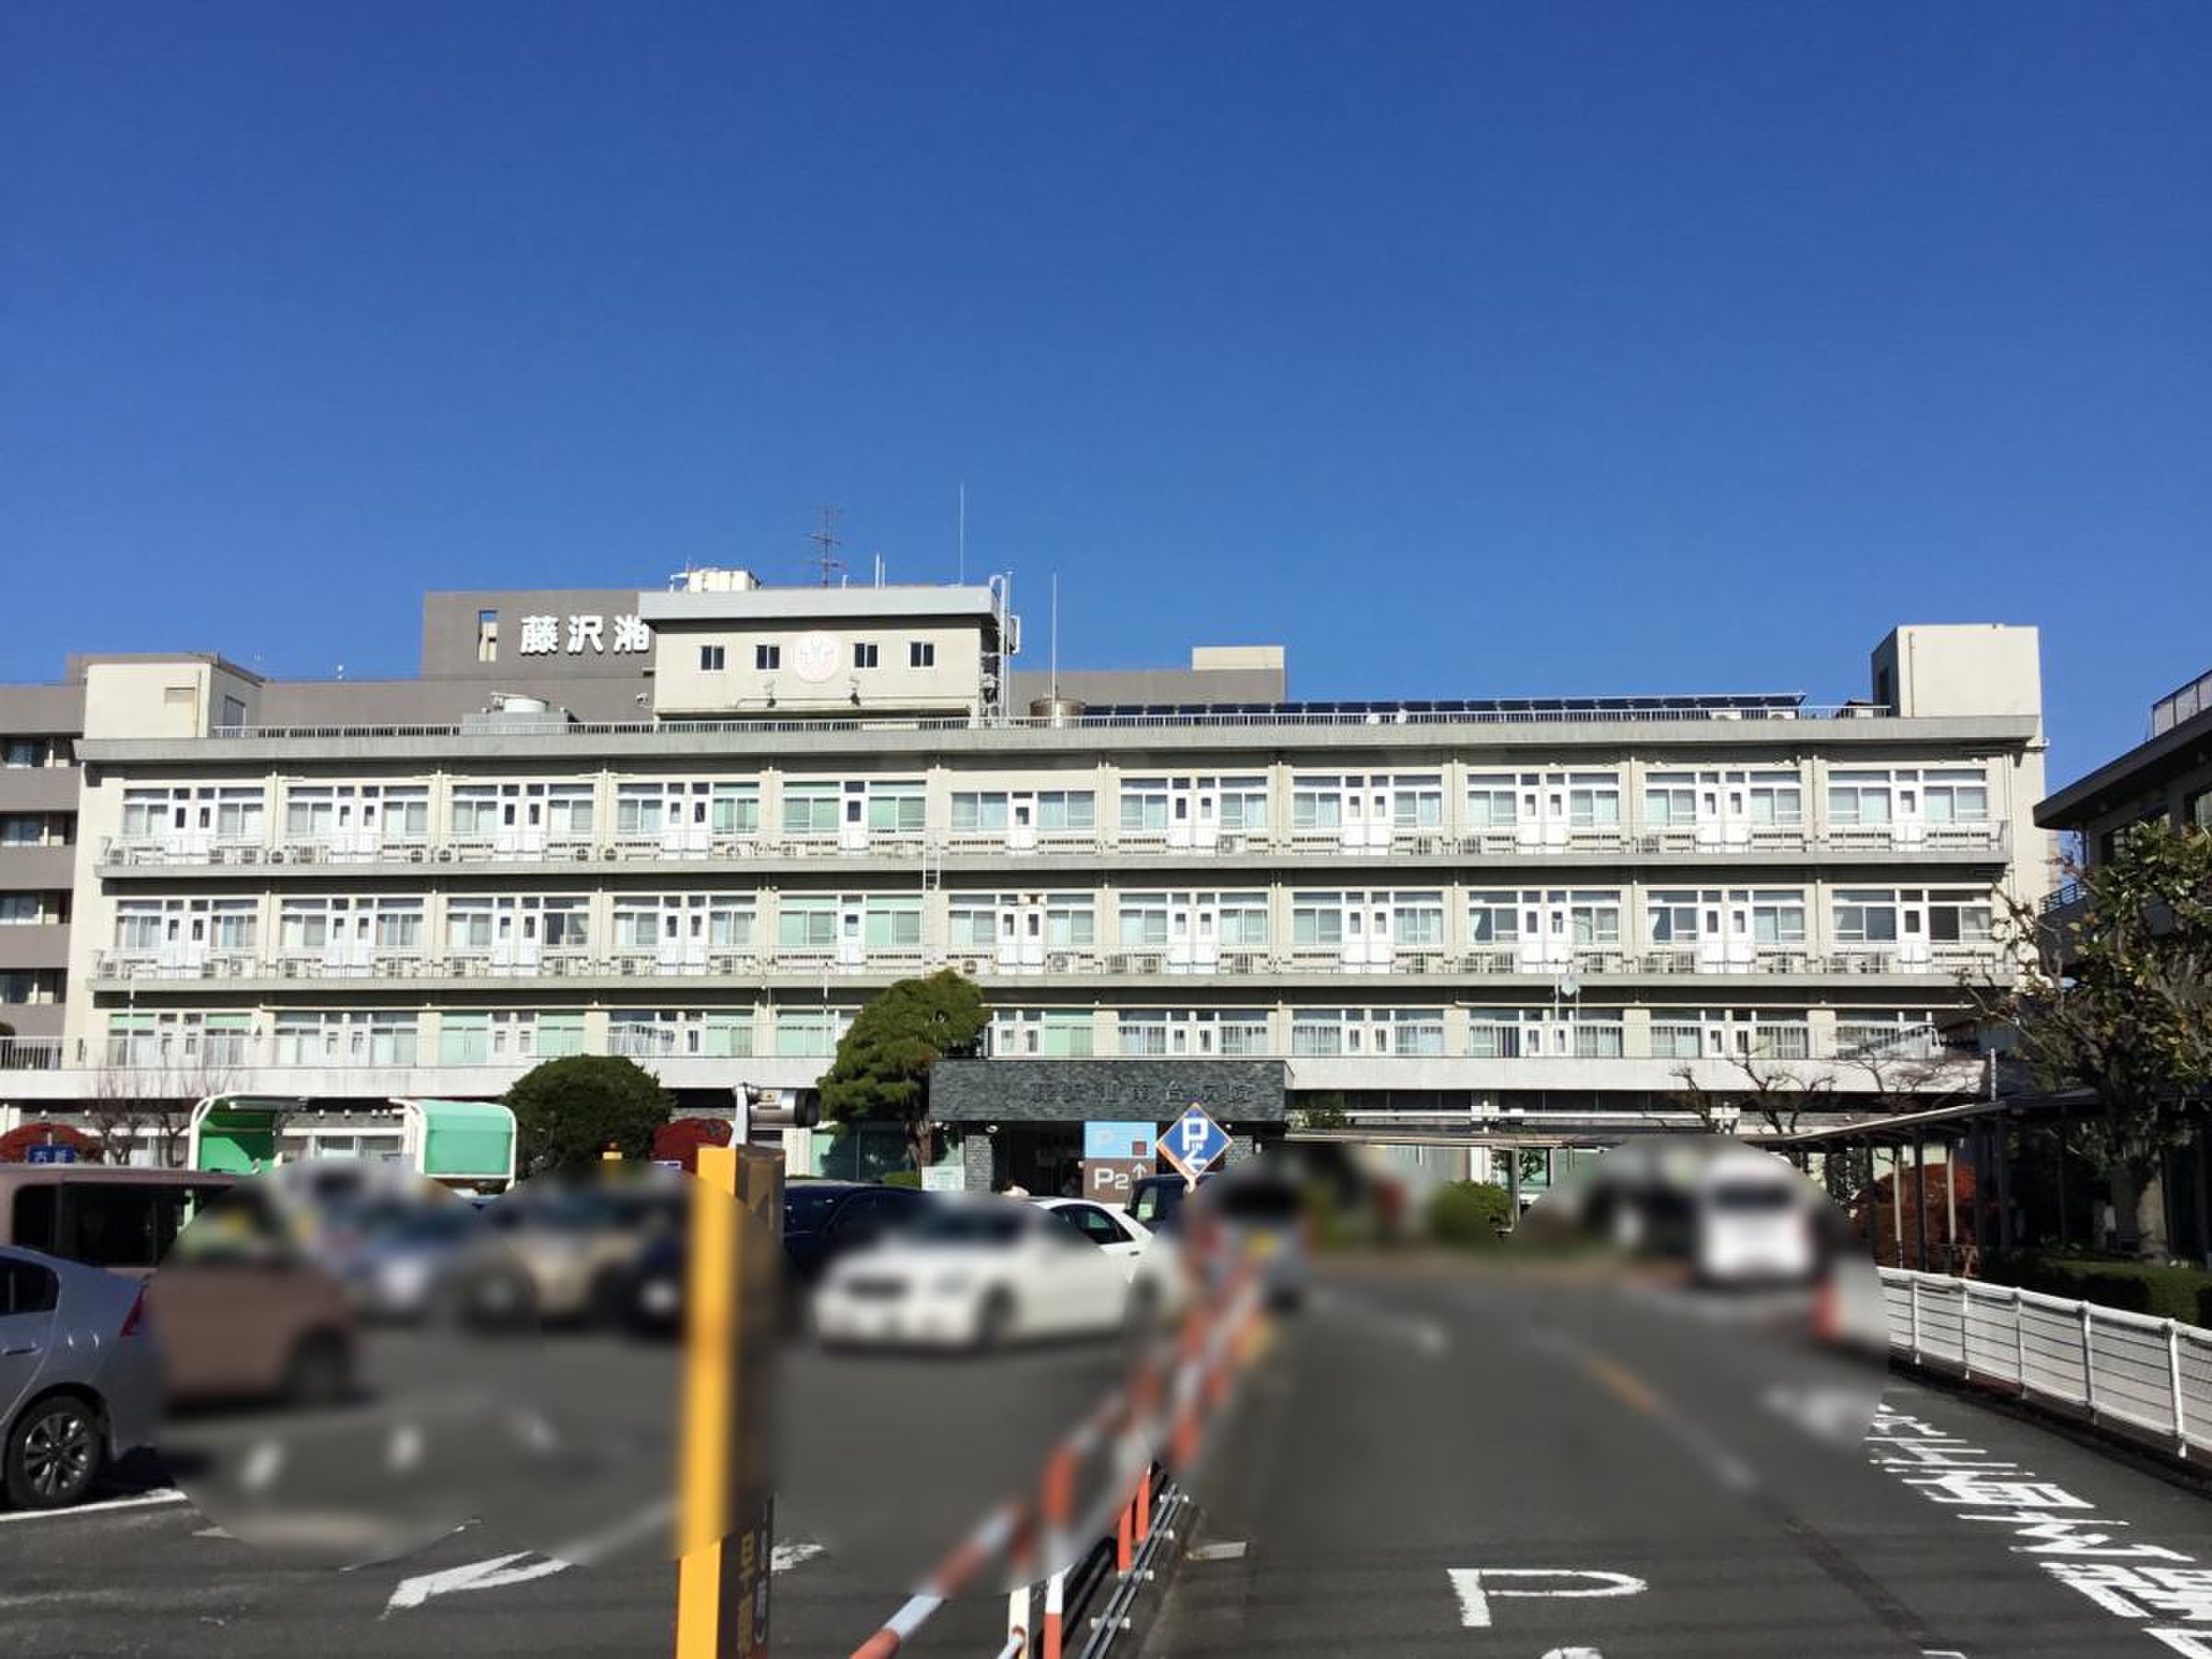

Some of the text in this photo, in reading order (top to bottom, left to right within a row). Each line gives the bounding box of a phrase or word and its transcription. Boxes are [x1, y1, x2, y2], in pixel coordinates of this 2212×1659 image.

[1182, 1118, 1208, 1151] P
[1094, 1168, 1130, 1191] P2
[1446, 1568, 1649, 1627] P
